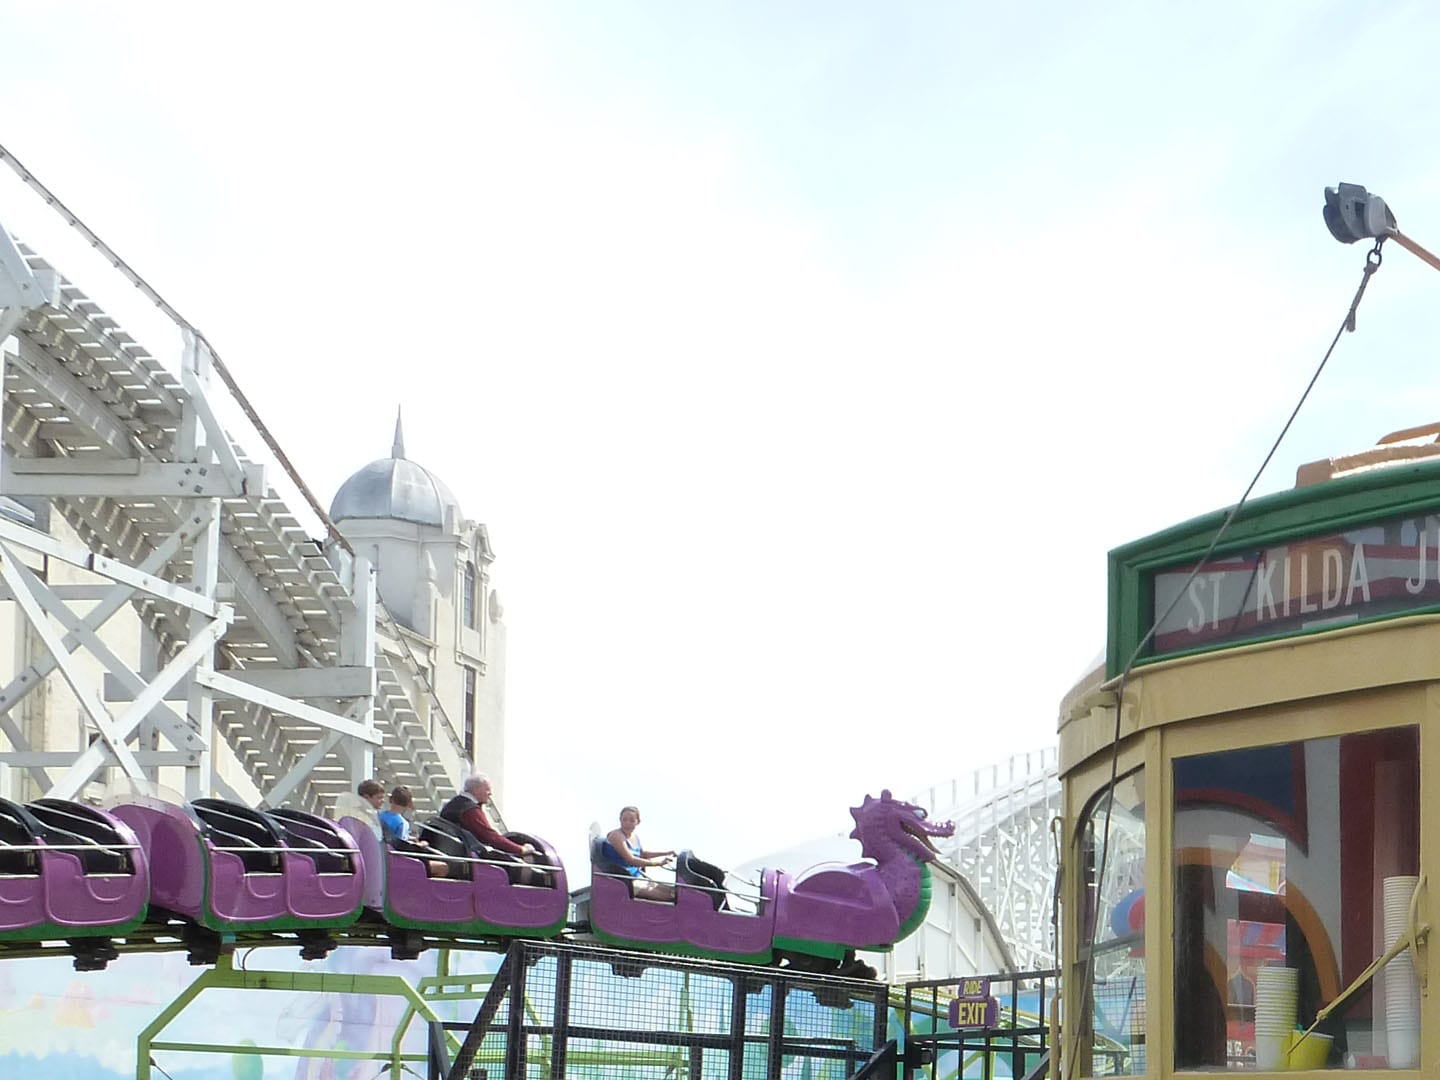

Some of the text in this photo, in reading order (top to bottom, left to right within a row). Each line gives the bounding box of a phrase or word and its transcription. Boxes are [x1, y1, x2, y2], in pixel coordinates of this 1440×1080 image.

[1186, 571, 1226, 635] ST
[1256, 542, 1372, 622] KILDA
[958, 1002, 988, 1025] EXIT
